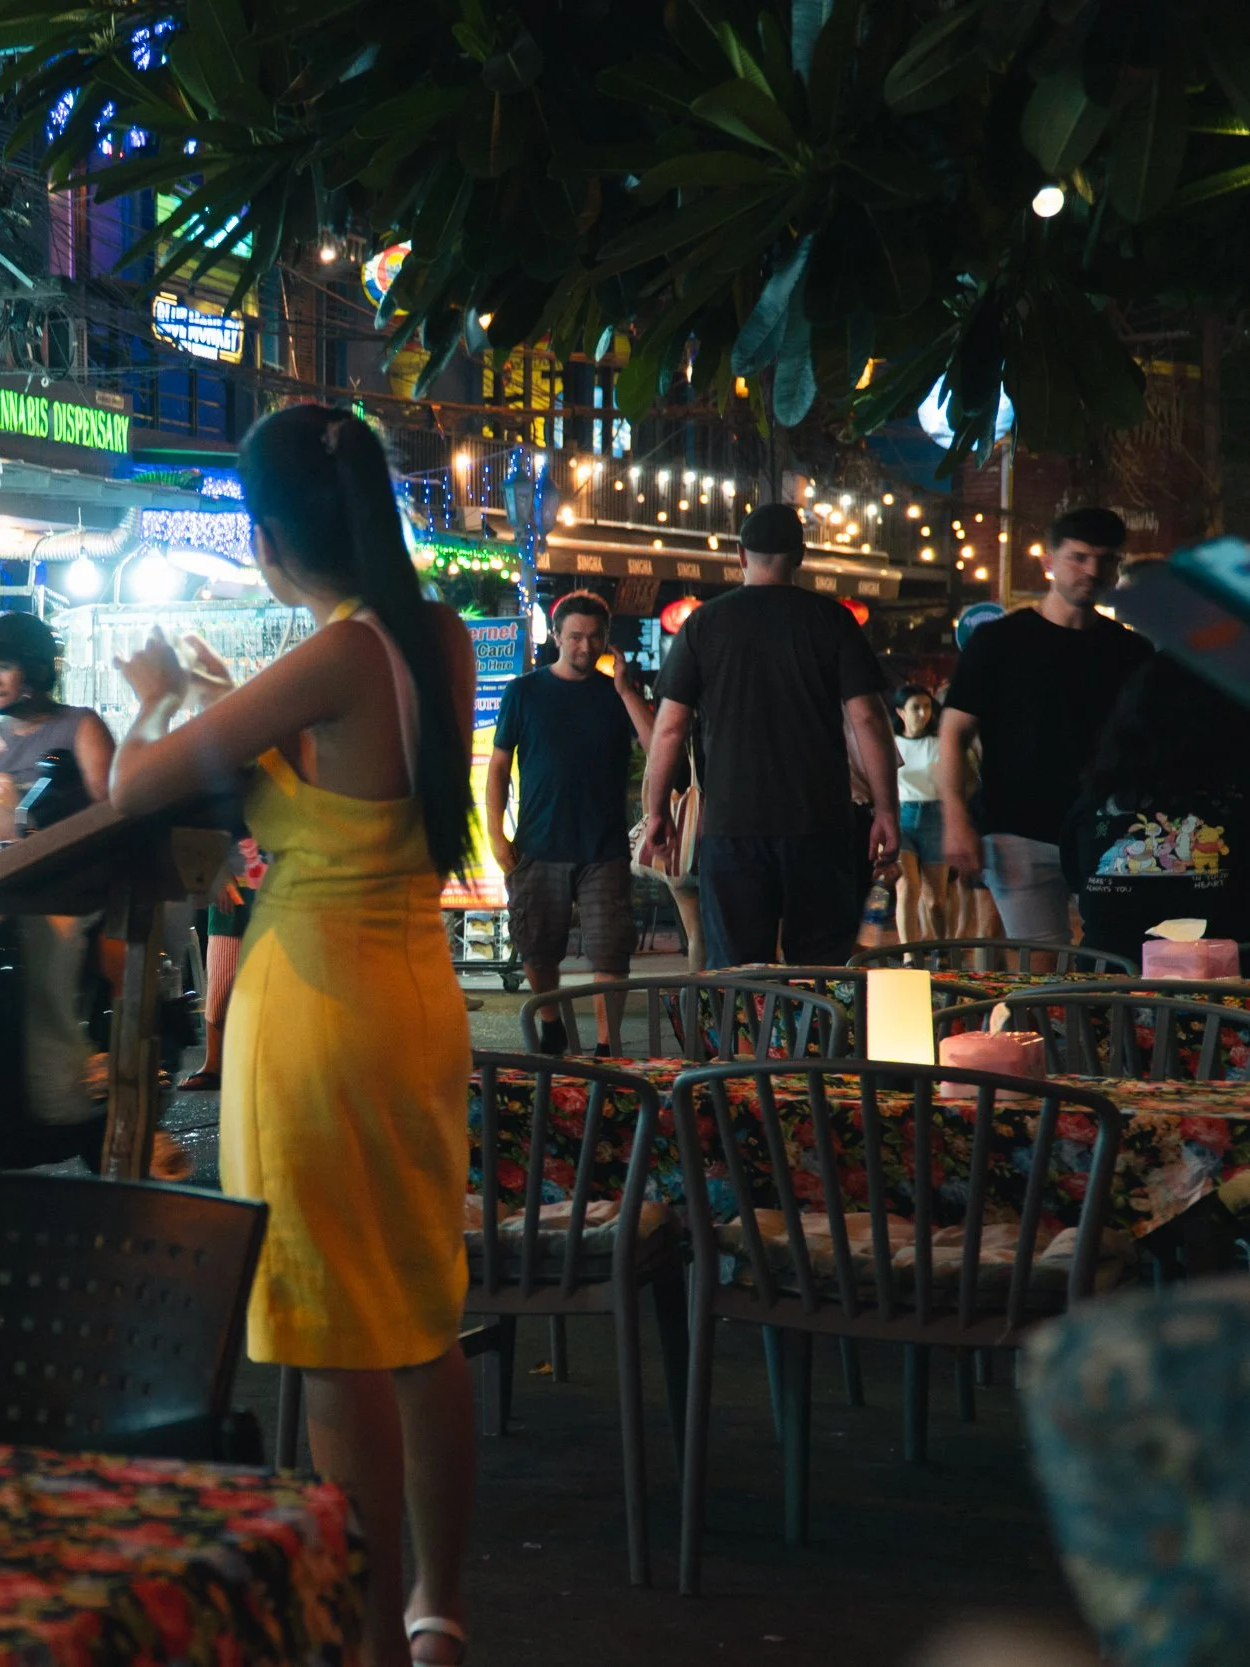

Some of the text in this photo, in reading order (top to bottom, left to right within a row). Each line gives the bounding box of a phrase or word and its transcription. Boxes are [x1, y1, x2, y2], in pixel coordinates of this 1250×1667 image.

[54, 400, 129, 454] DISPENSARY
[577, 554, 603, 573] SINGHA
[627, 558, 653, 576] SINGHA
[477, 641, 516, 658] Card
[488, 659, 514, 671] Here
[1115, 885, 1132, 893] YOU
